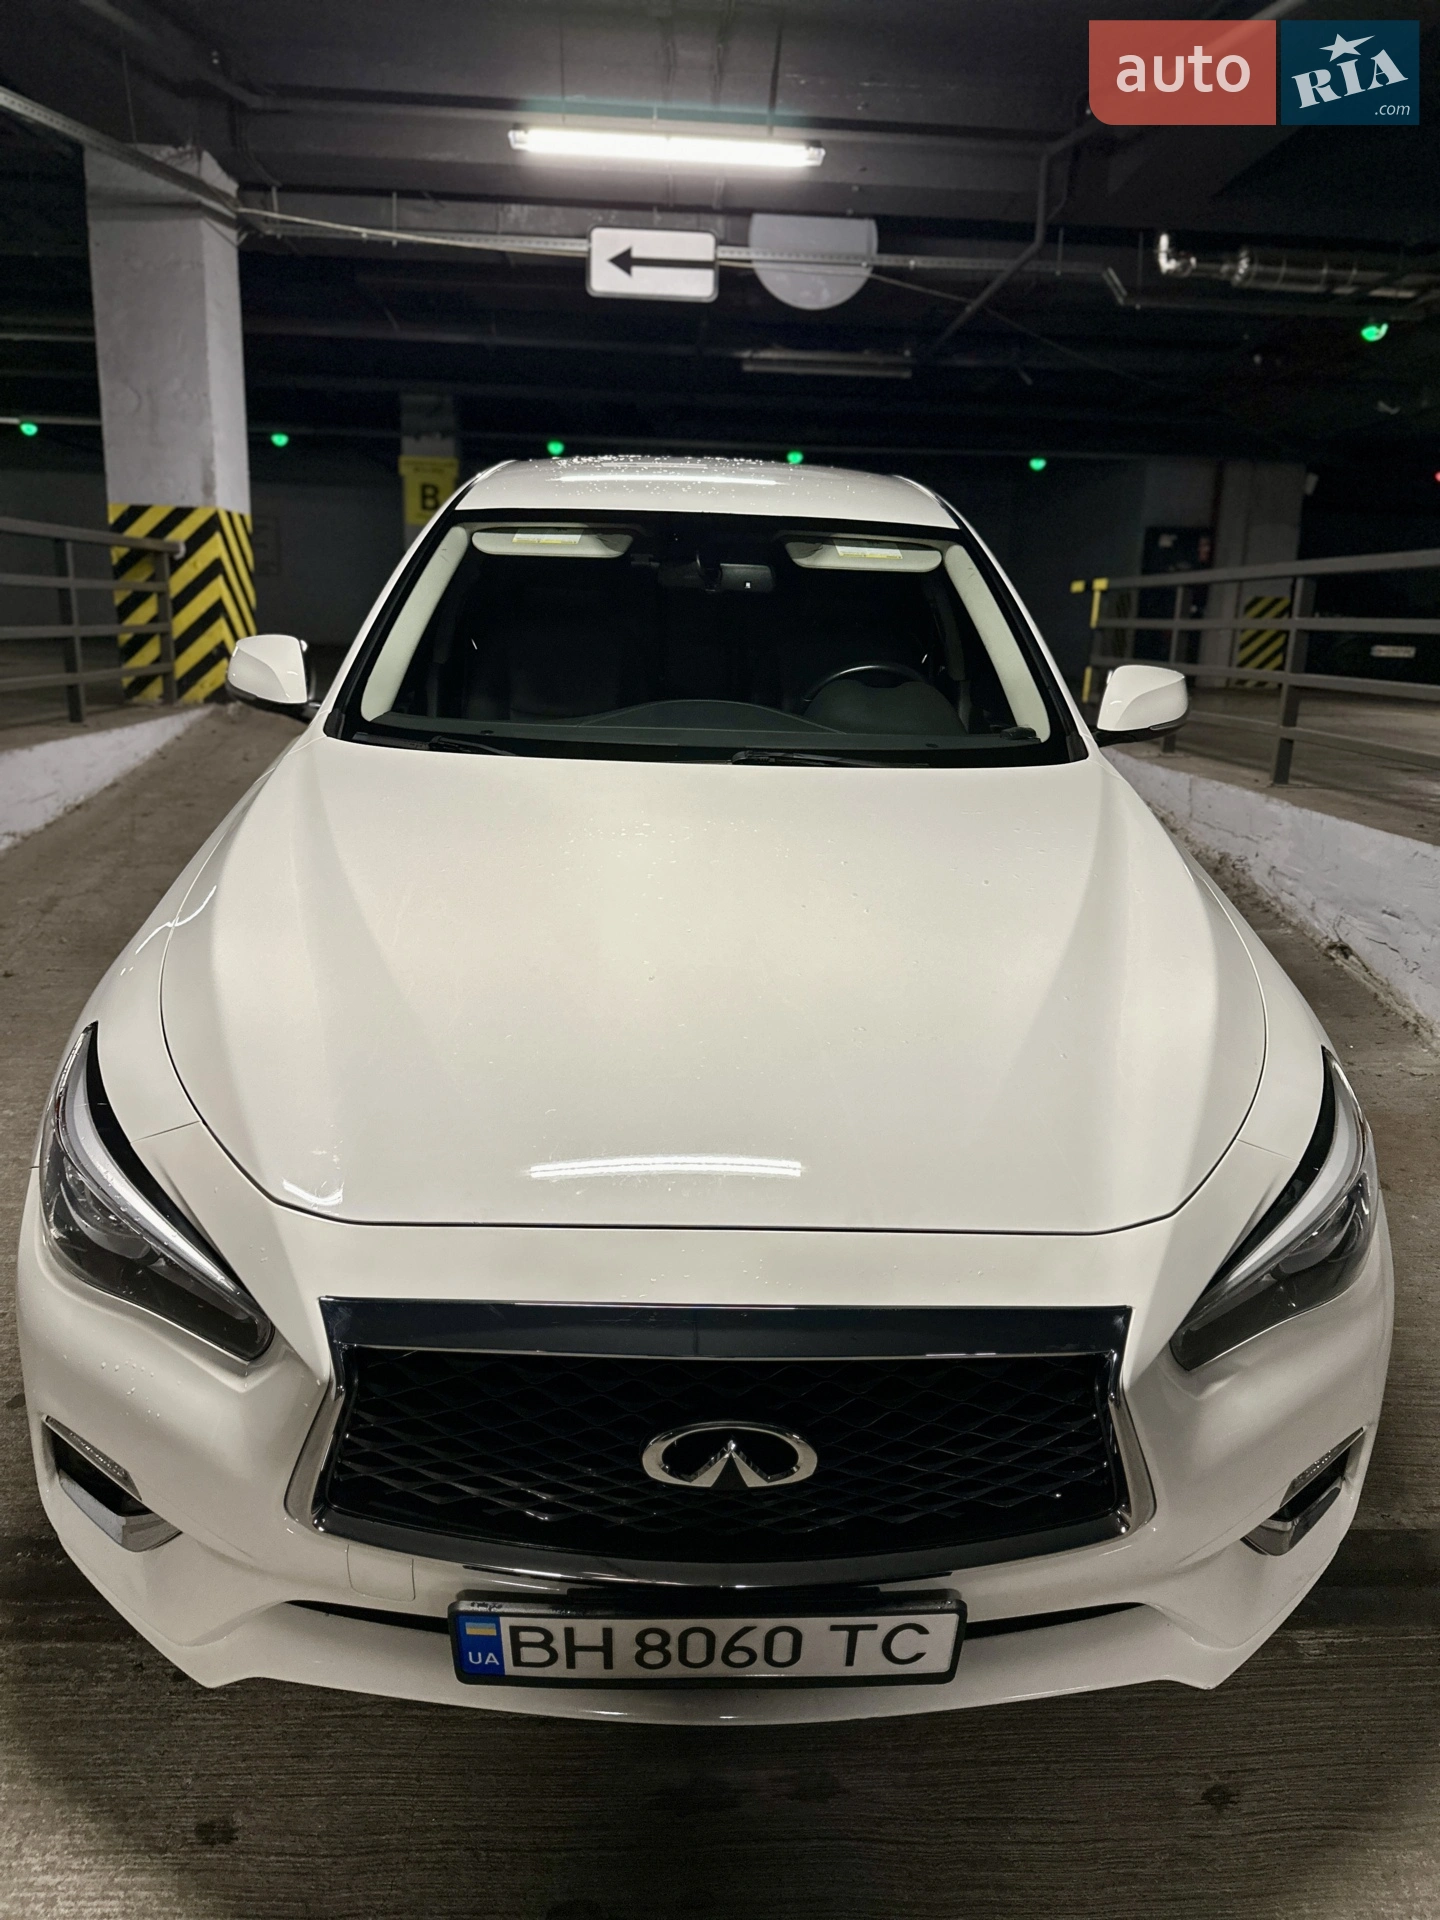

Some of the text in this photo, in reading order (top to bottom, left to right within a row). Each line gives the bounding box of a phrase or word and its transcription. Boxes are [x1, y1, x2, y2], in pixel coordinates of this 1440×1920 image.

[468, 1652, 500, 1666] UA
[509, 1622, 930, 1670] BH 8060 TC
